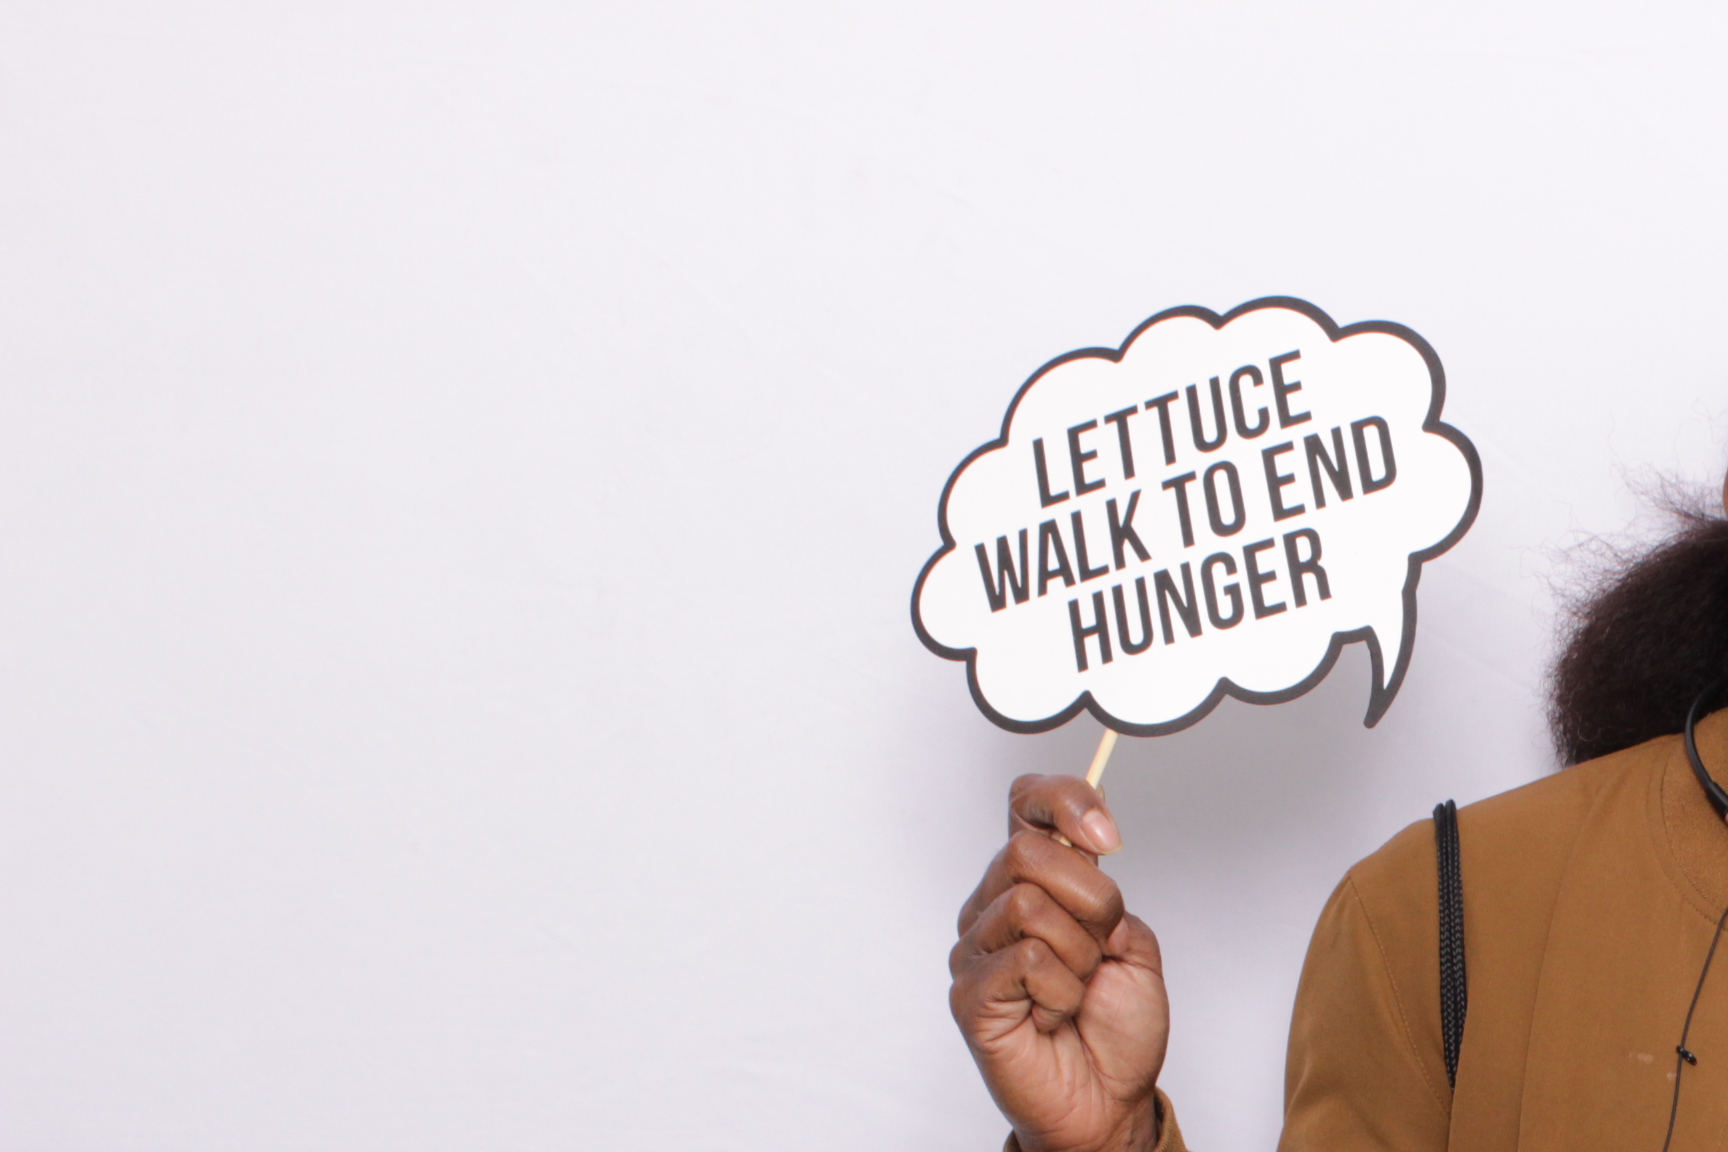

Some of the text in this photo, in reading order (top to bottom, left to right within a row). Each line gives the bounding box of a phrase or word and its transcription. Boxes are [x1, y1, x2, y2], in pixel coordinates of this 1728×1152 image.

[1032, 349, 1312, 509] LETTUCE
[974, 415, 1397, 613] WALK TO END
[1068, 527, 1332, 673] HUNGER
